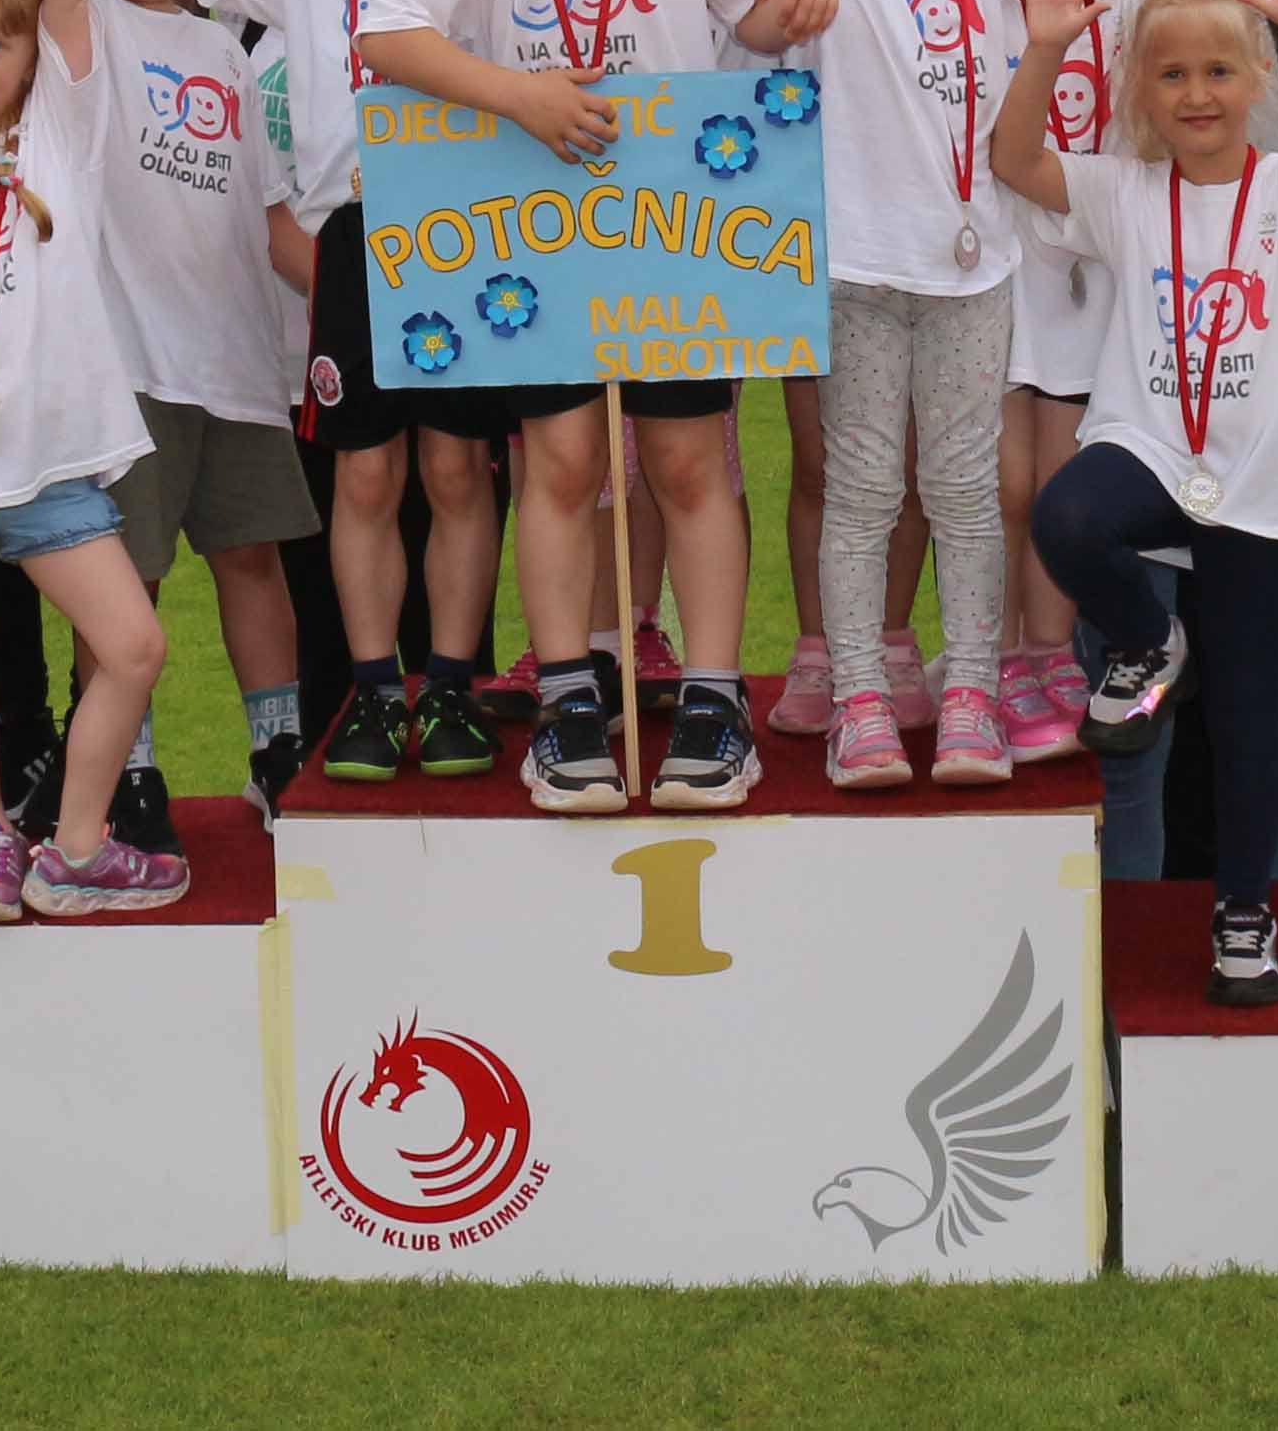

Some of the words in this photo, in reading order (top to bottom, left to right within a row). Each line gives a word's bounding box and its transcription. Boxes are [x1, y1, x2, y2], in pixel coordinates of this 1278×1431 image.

[529, 41, 551, 61] JA
[955, 56, 987, 78] BTI
[172, 140, 199, 165] ĆU
[367, 160, 816, 289] POTOČNICA
[589, 294, 729, 335] MALA
[594, 336, 820, 382] SUBOTICA
[1220, 353, 1255, 374] BITI
[1150, 376, 1251, 400] OLIPJAC
[609, 838, 731, 976] 1
[299, 1154, 378, 1237] ATLETSKI
[382, 1227, 441, 1252] KLUB
